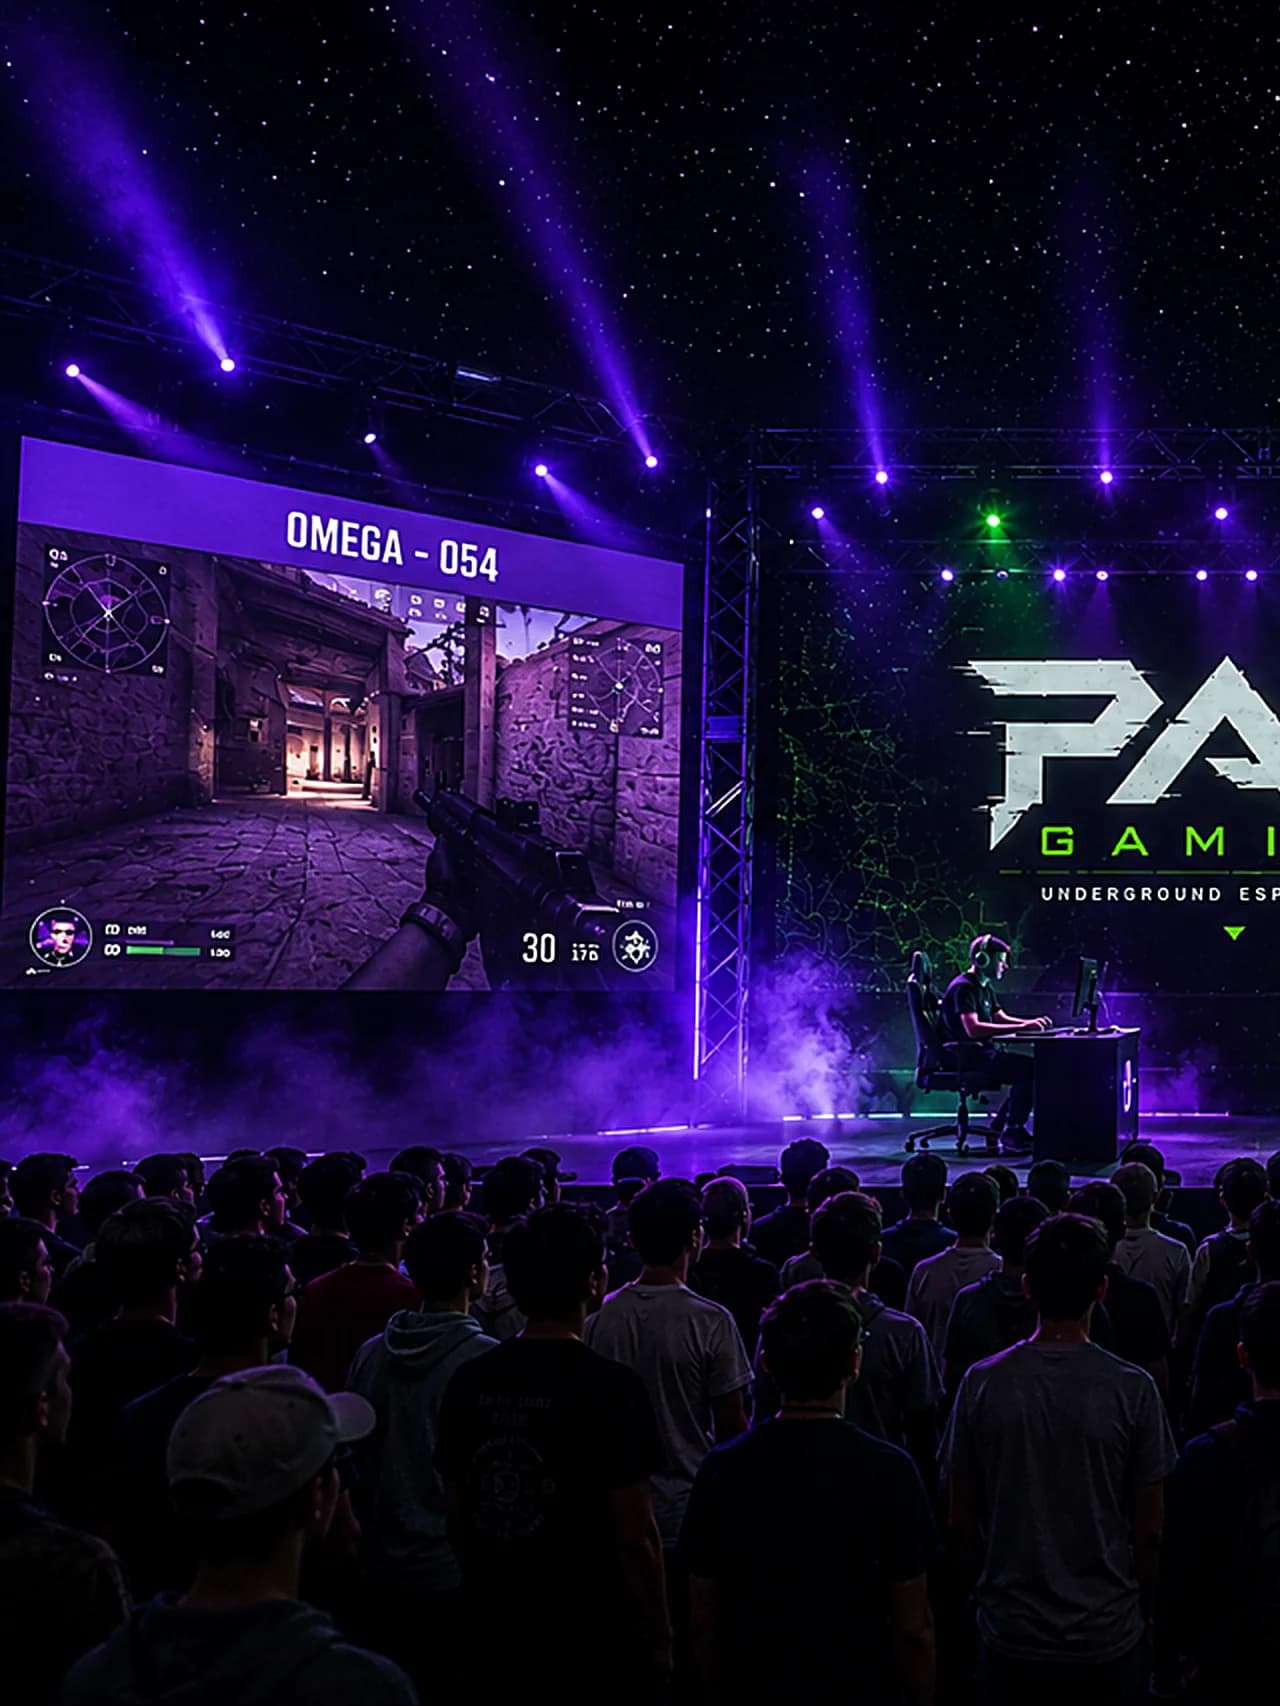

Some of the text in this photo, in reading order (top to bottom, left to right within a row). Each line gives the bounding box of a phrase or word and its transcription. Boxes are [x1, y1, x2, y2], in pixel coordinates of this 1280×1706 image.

[287, 511, 403, 566] OMEGA
[440, 540, 499, 582] 054
[1041, 886, 1221, 902] UNDERGROUND
[522, 932, 556, 963] 30
